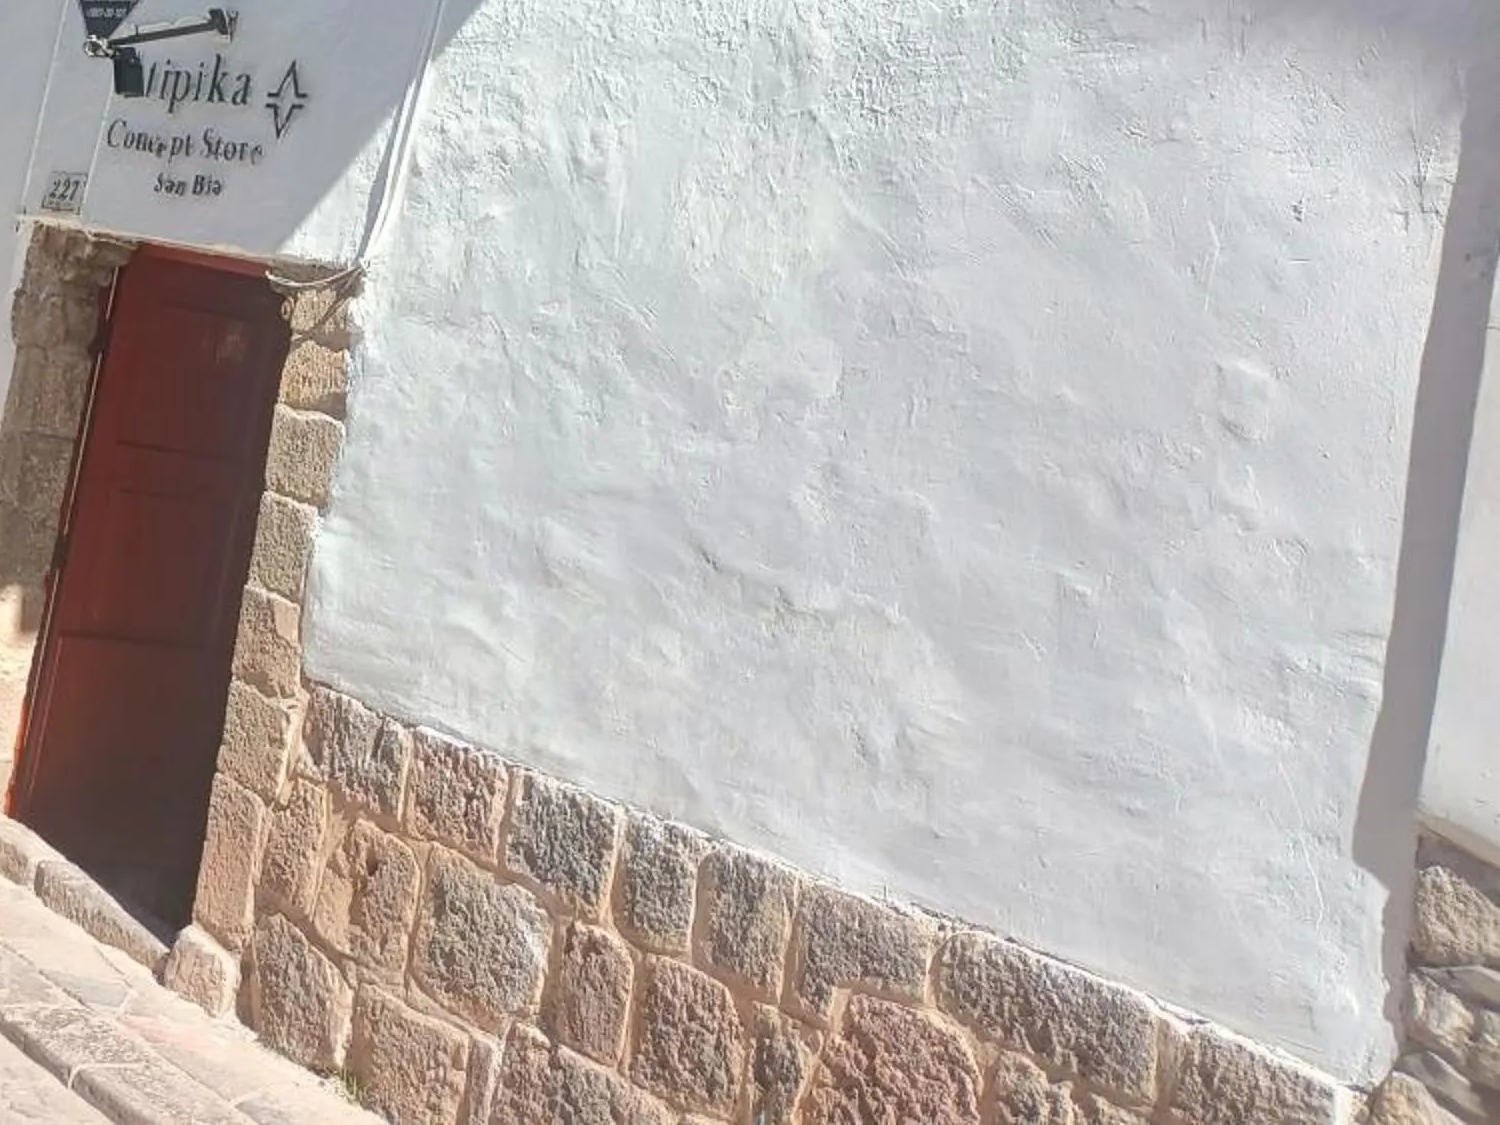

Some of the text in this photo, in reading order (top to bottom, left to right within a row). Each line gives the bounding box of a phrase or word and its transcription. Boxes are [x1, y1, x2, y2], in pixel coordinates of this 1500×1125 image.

[144, 53, 252, 113] tipika
[107, 119, 264, 165] Concept Store
[49, 177, 80, 201] 227
[153, 172, 187, 196] San
